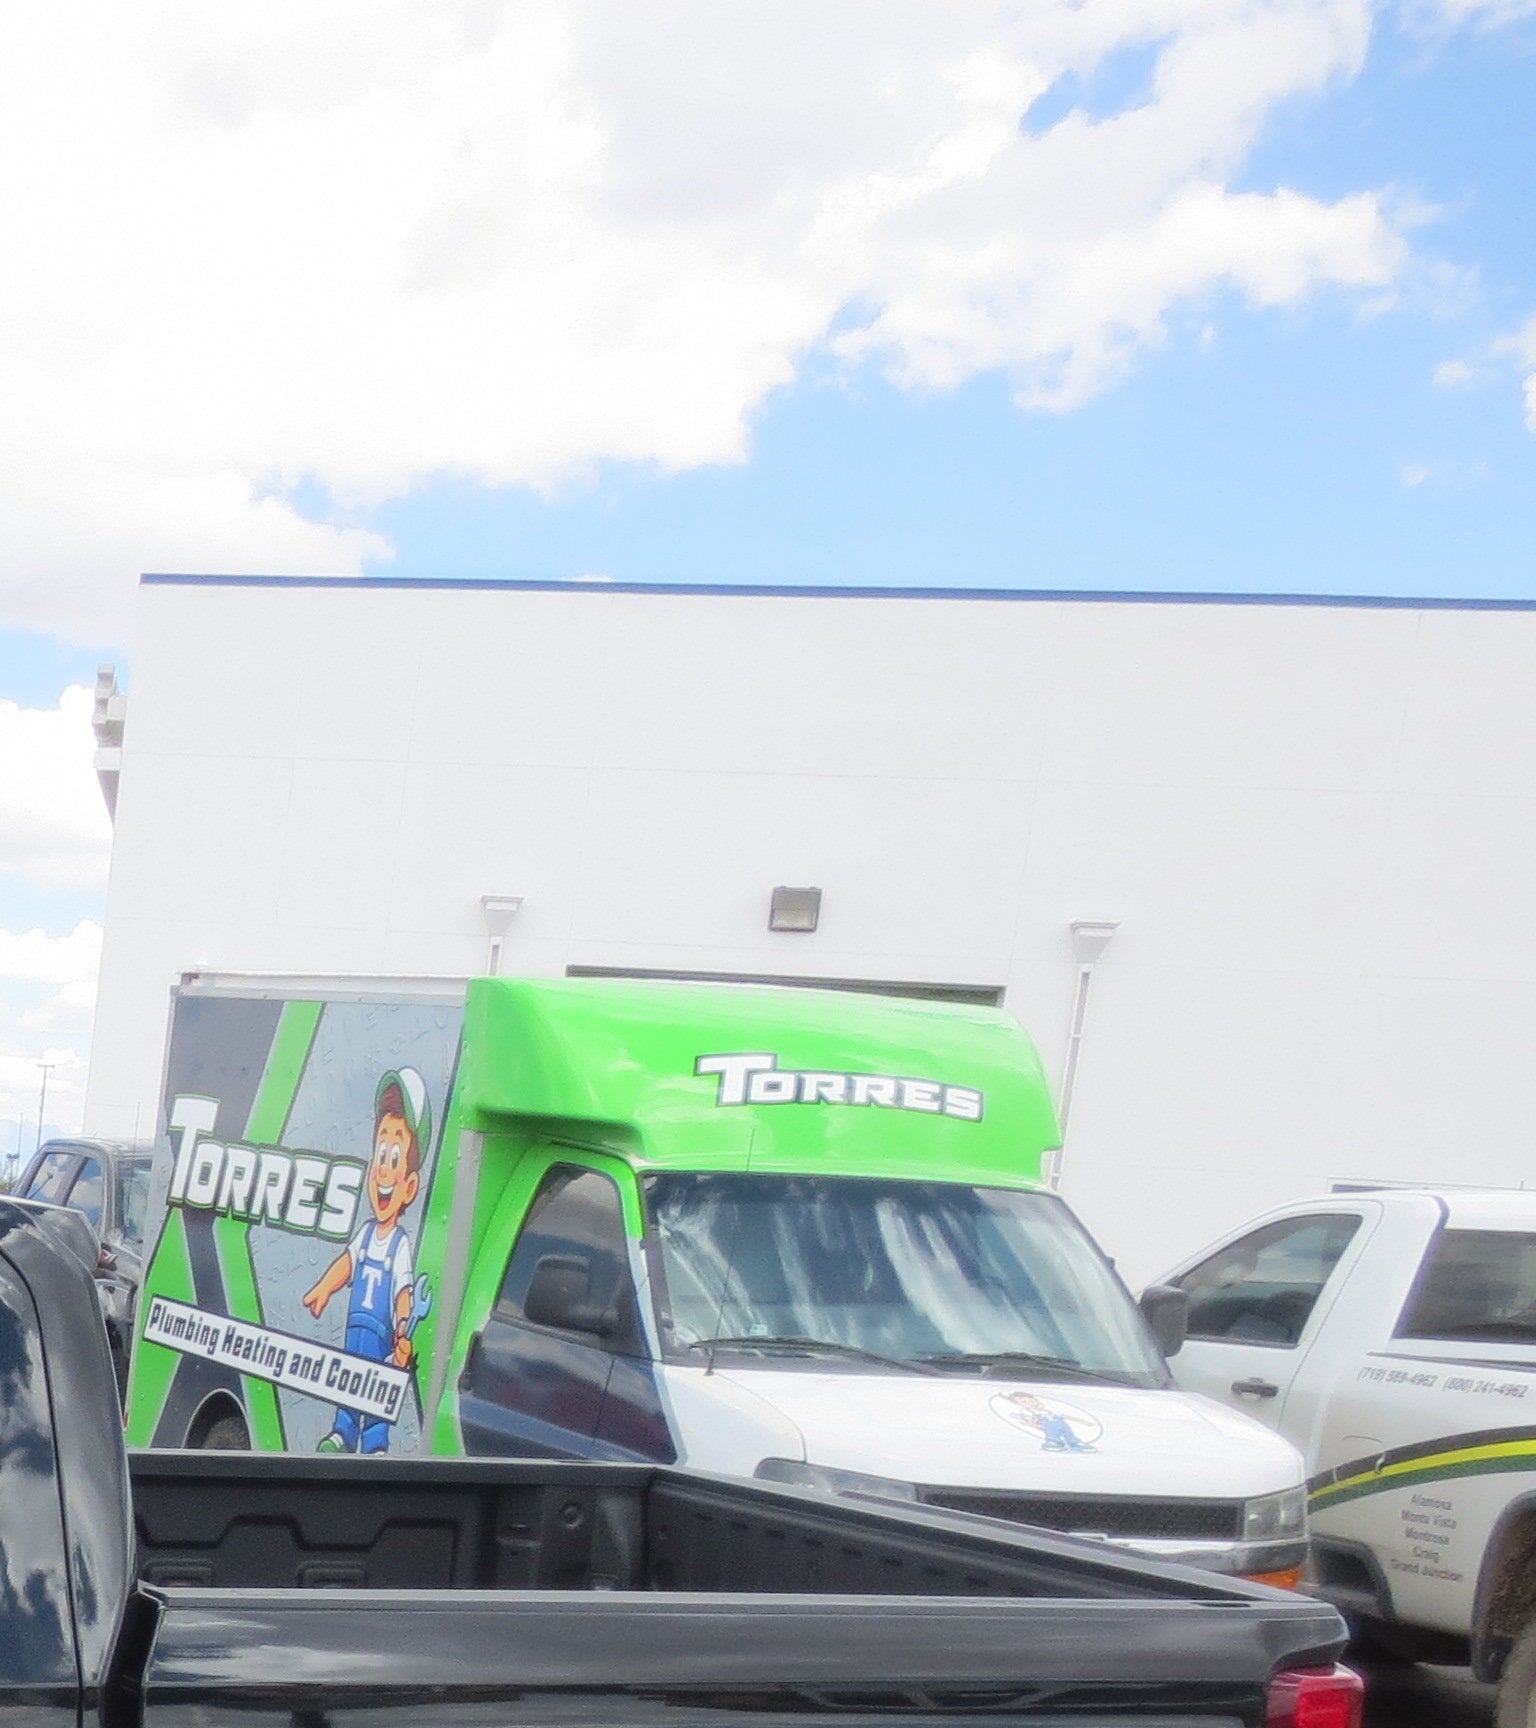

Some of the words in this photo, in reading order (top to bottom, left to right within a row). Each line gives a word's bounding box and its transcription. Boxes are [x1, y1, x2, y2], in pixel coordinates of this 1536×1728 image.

[149, 1303, 220, 1355] Plumbing
[221, 1325, 288, 1376] Heating
[288, 1349, 325, 1383] and
[325, 1358, 402, 1415] Cooling
